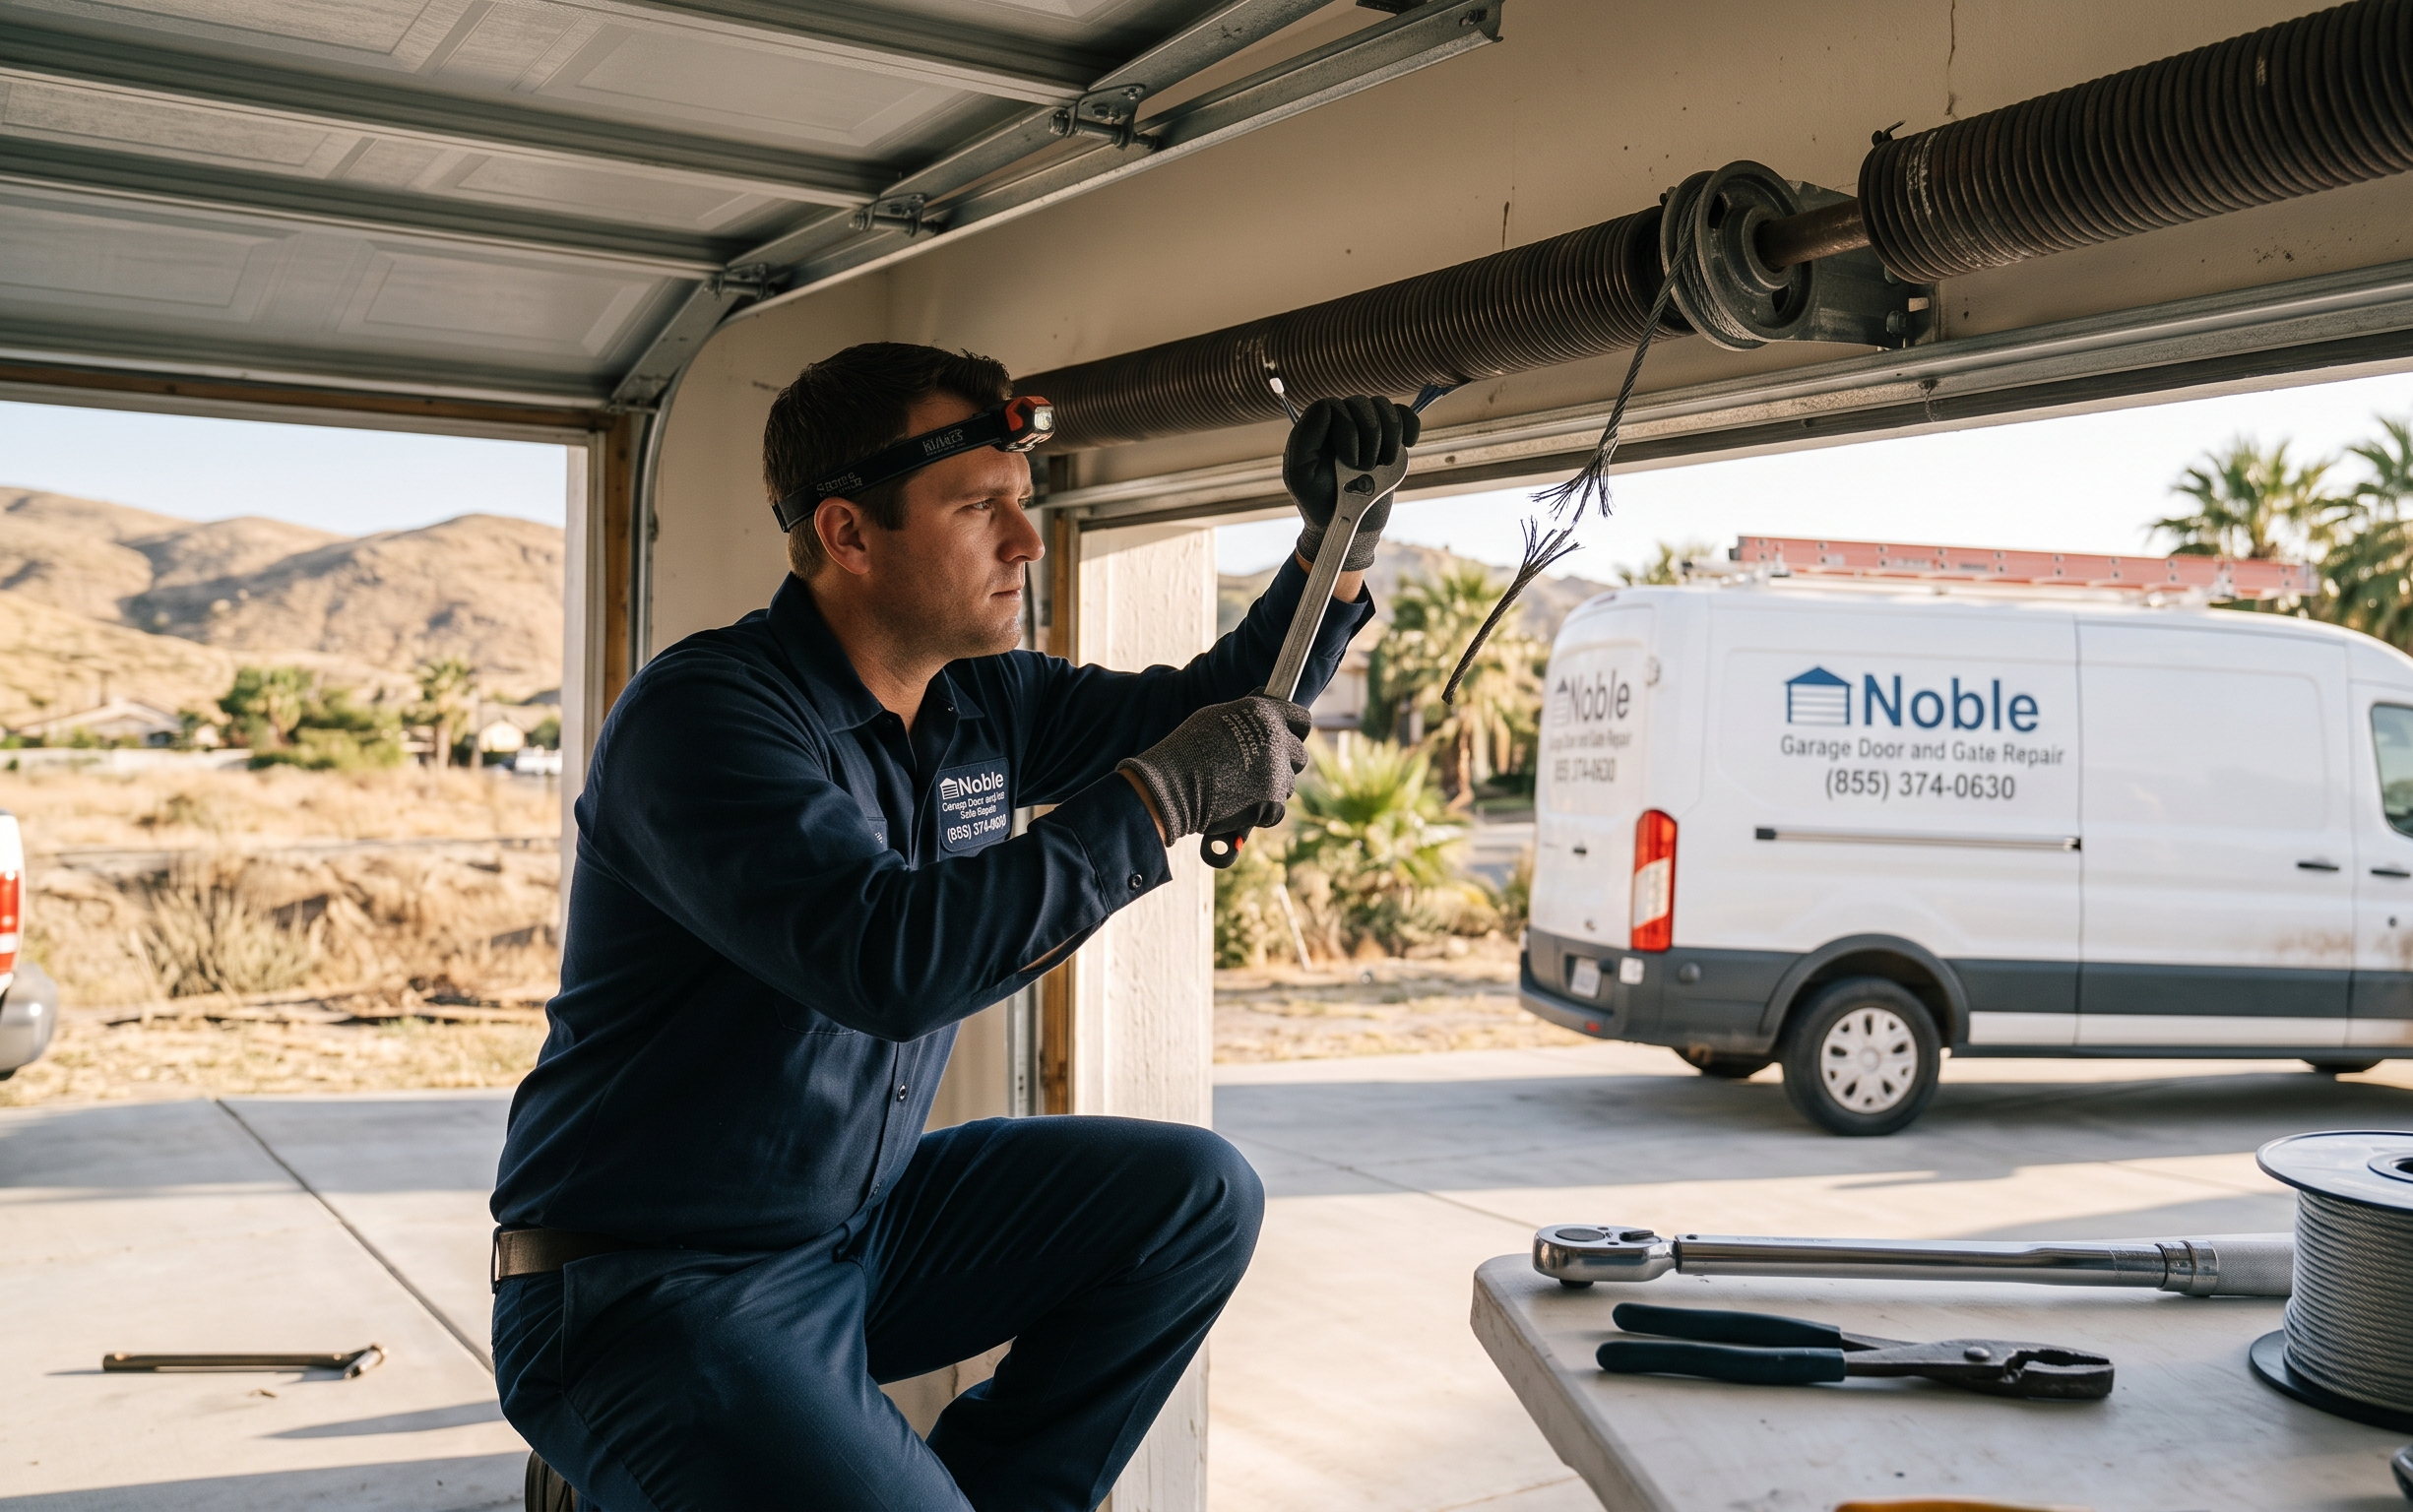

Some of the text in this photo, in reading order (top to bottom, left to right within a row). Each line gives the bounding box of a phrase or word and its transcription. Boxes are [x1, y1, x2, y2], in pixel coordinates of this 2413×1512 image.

[1571, 669, 1630, 722] Noble
[1864, 673, 2039, 732] Noble
[1780, 734, 2064, 769] Garage Door and Gate Repair
[958, 771, 1004, 796] Noble
[1825, 768, 2016, 802] (855) 374-0630
